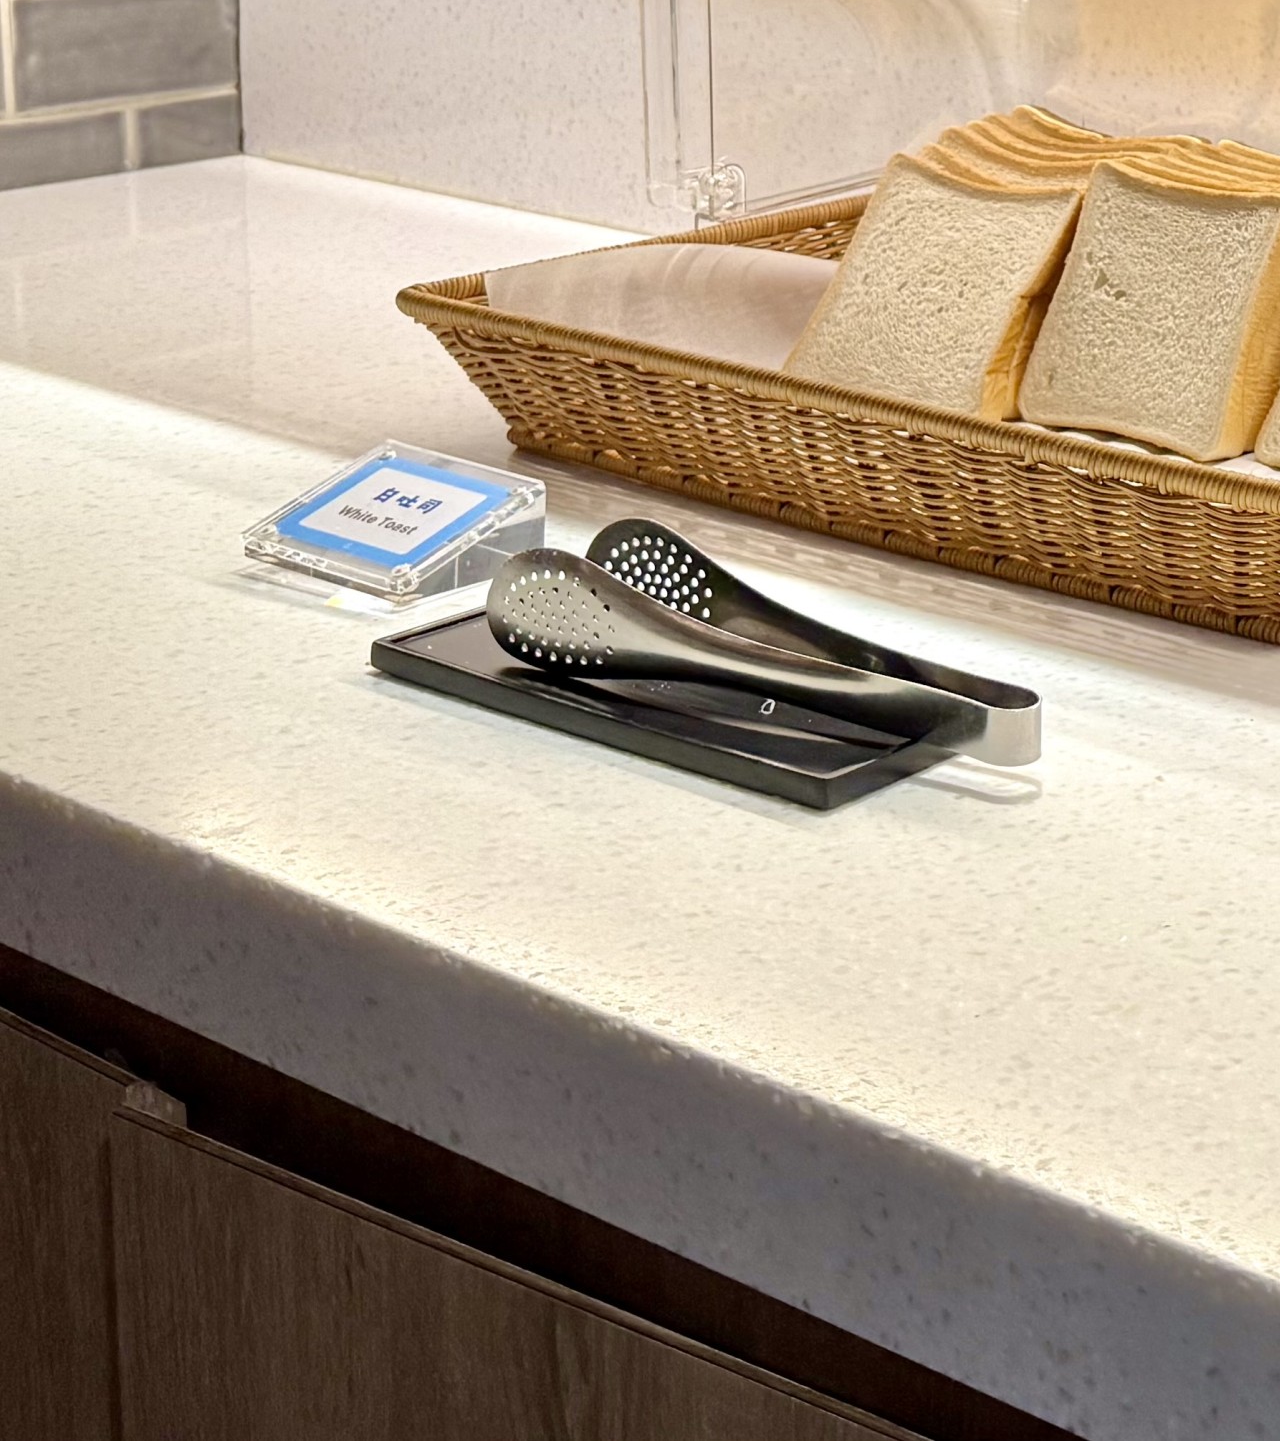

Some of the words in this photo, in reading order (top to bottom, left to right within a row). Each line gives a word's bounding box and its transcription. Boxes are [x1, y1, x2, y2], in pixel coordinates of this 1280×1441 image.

[373, 487, 443, 514] 白吐司
[338, 505, 378, 524] White
[378, 516, 418, 535] Toast
